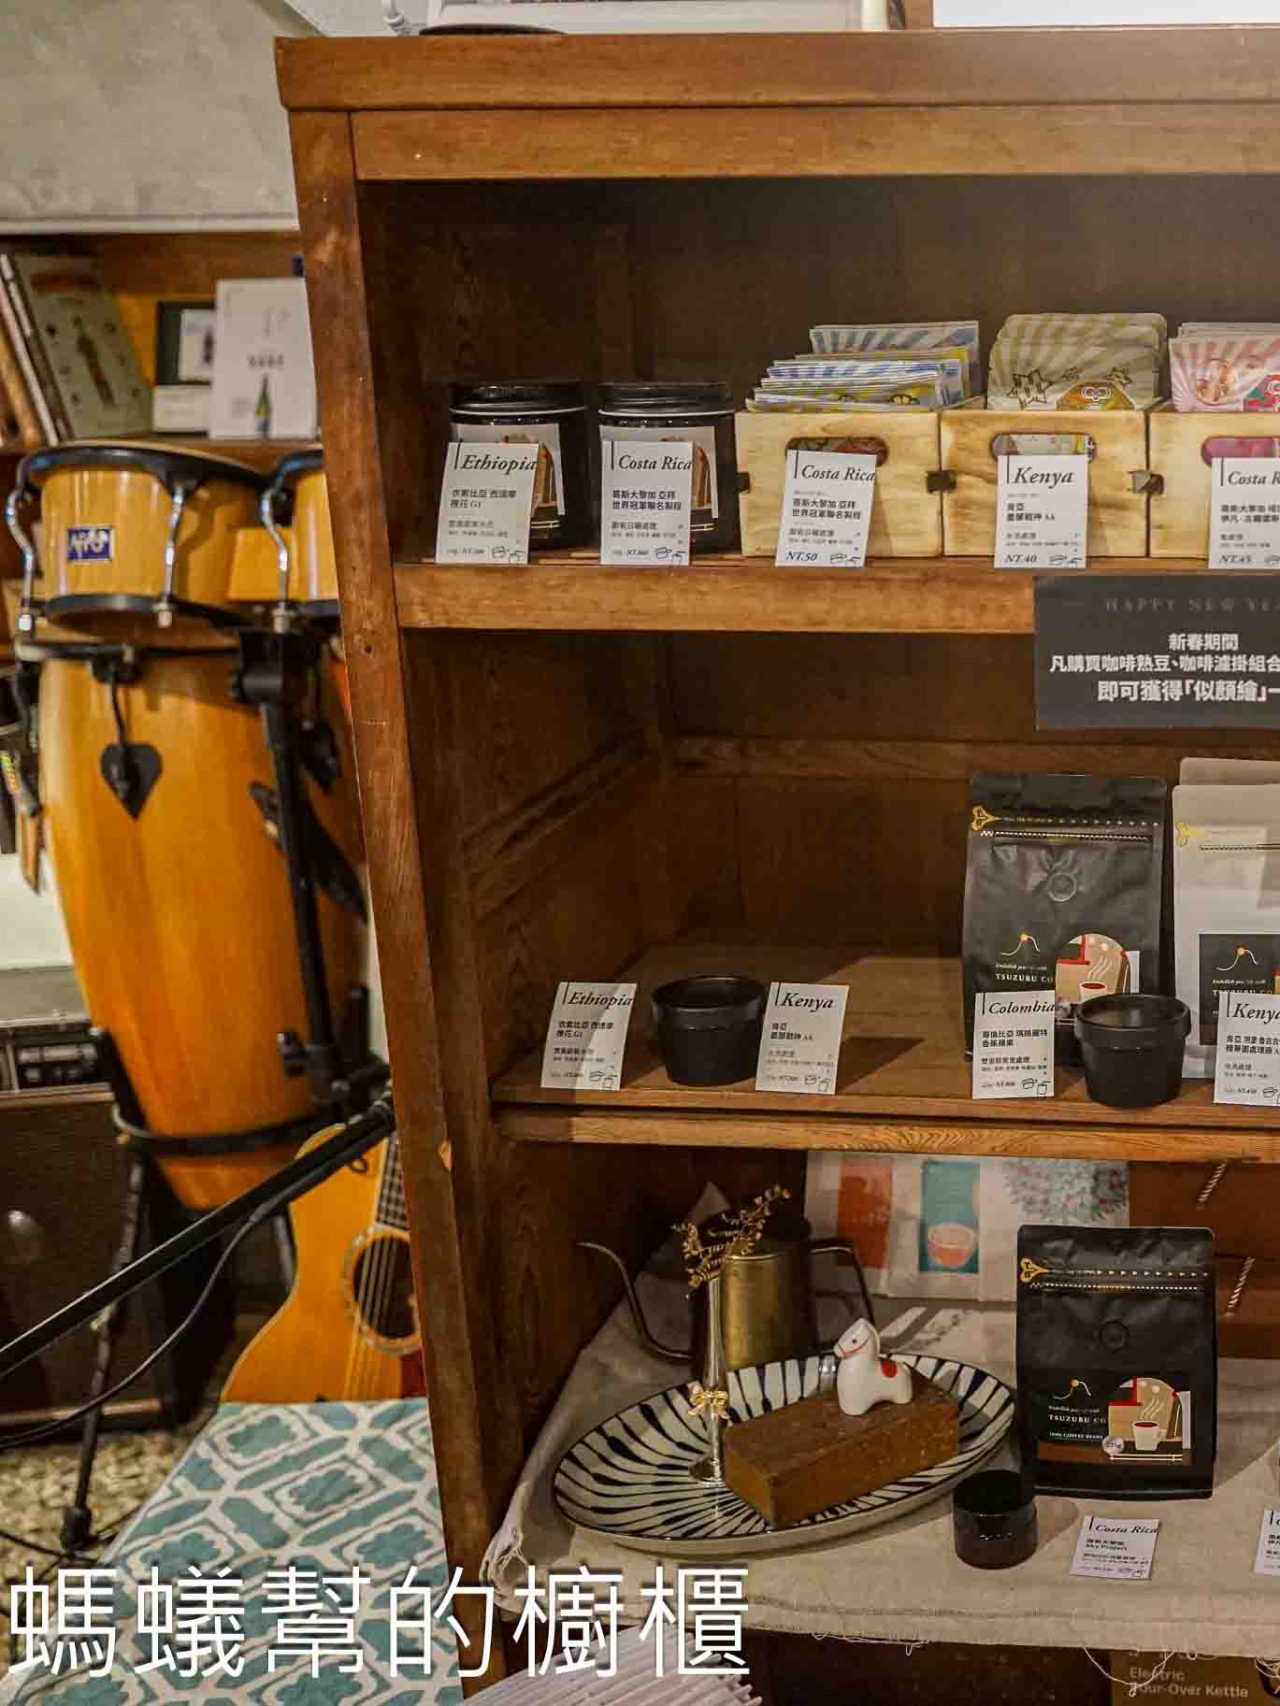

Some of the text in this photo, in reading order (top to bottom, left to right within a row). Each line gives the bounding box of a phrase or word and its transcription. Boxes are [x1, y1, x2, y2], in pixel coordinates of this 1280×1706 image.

[460, 454, 537, 476] Ethiopia
[618, 454, 692, 470] Costa Rica
[801, 464, 876, 482] Costa Rica
[1013, 467, 1073, 489] Kenya
[1227, 470, 1267, 485] Costa
[785, 551, 818, 561] NT.50
[1005, 554, 1038, 563] NT.40
[1106, 598, 1175, 612] HAPPY
[1189, 598, 1234, 612] NEW
[1168, 634, 1239, 651] 新春期間
[995, 973, 1038, 982] TSUZURU
[567, 991, 634, 1010] Ethiopia
[780, 992, 834, 1014] Kenya
[988, 1000, 1056, 1014] Colombia
[1048, 1414, 1090, 1423] TSUZURU
[1095, 1523, 1160, 1535] Costa Rica
[1205, 1684, 1249, 1699] Kettle
